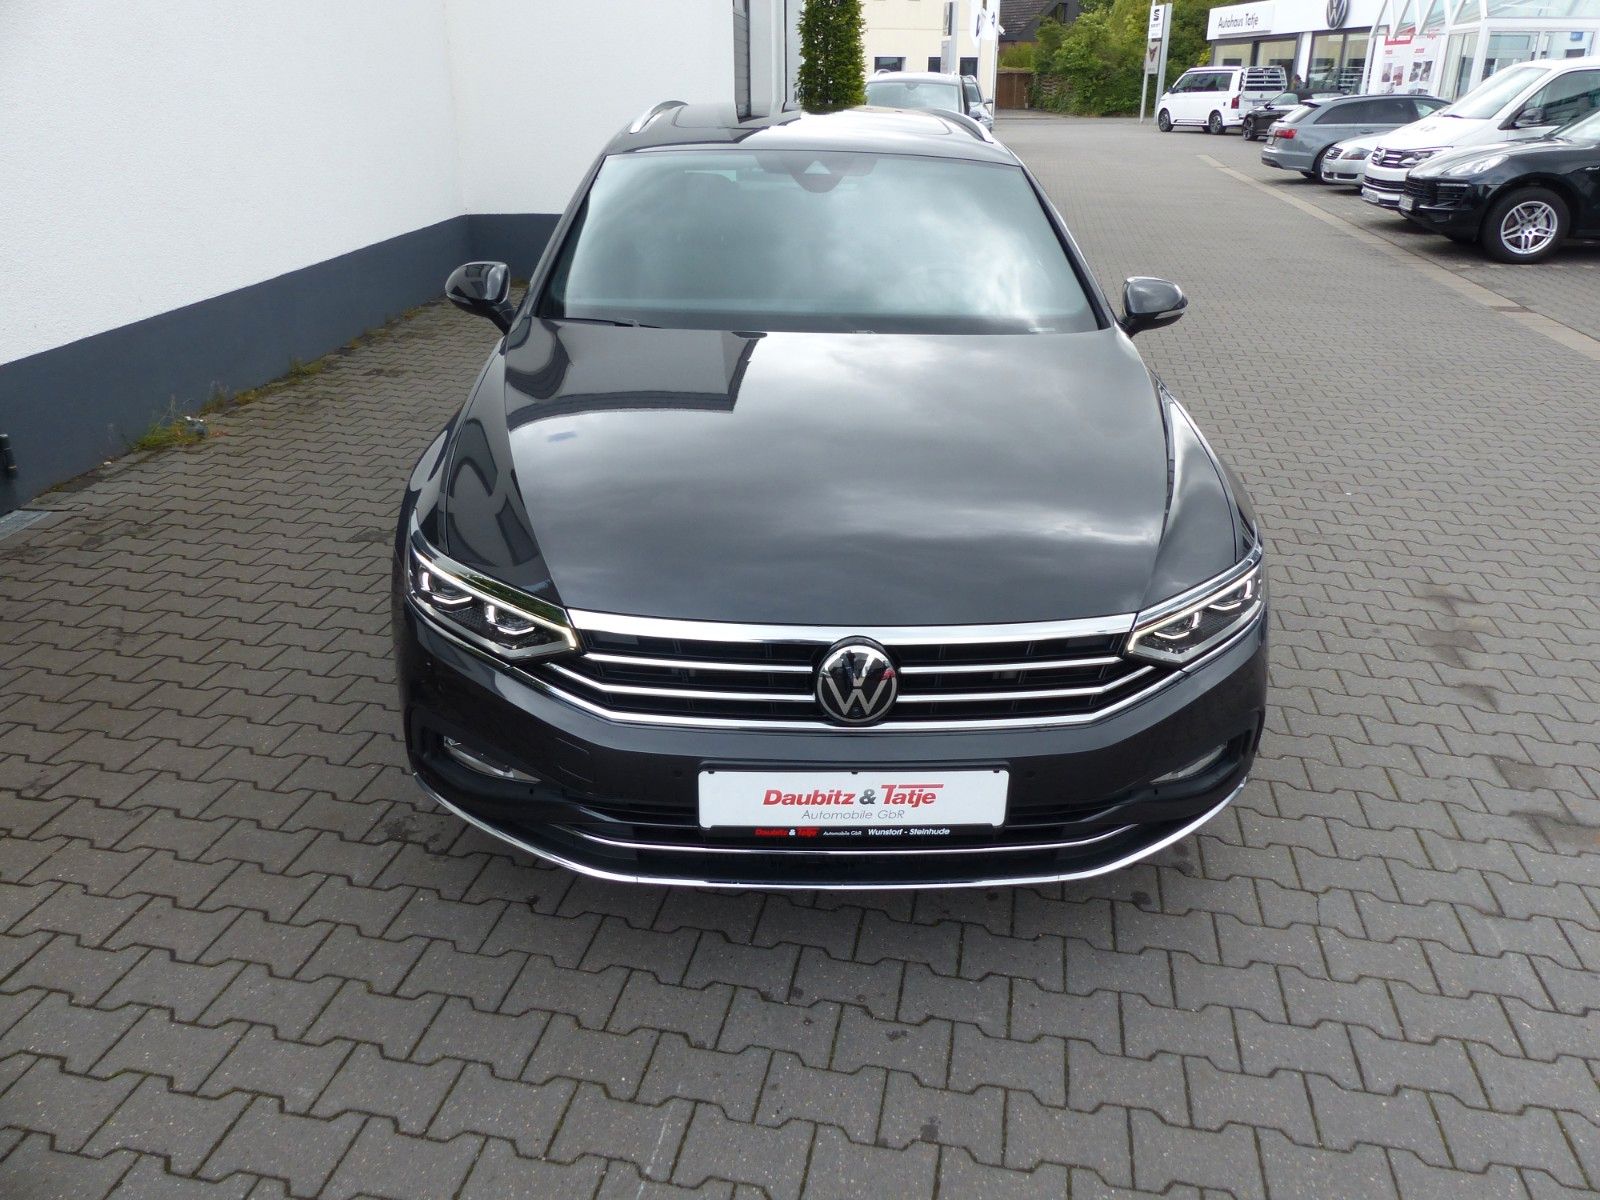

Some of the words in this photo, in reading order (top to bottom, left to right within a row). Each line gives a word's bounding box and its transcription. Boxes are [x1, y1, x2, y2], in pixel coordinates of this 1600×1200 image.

[1218, 15, 1244, 28] Autohaus
[1245, 13, 1259, 28] Tatje
[763, 789, 855, 806] Daubitz
[859, 789, 876, 805] &
[881, 783, 944, 808] Tatje
[801, 809, 873, 820] Automobile
[878, 809, 905, 819] GbR
[754, 828, 788, 837] Daubitz
[868, 828, 903, 836] Wunstorf
[909, 828, 950, 836] Steinhude
